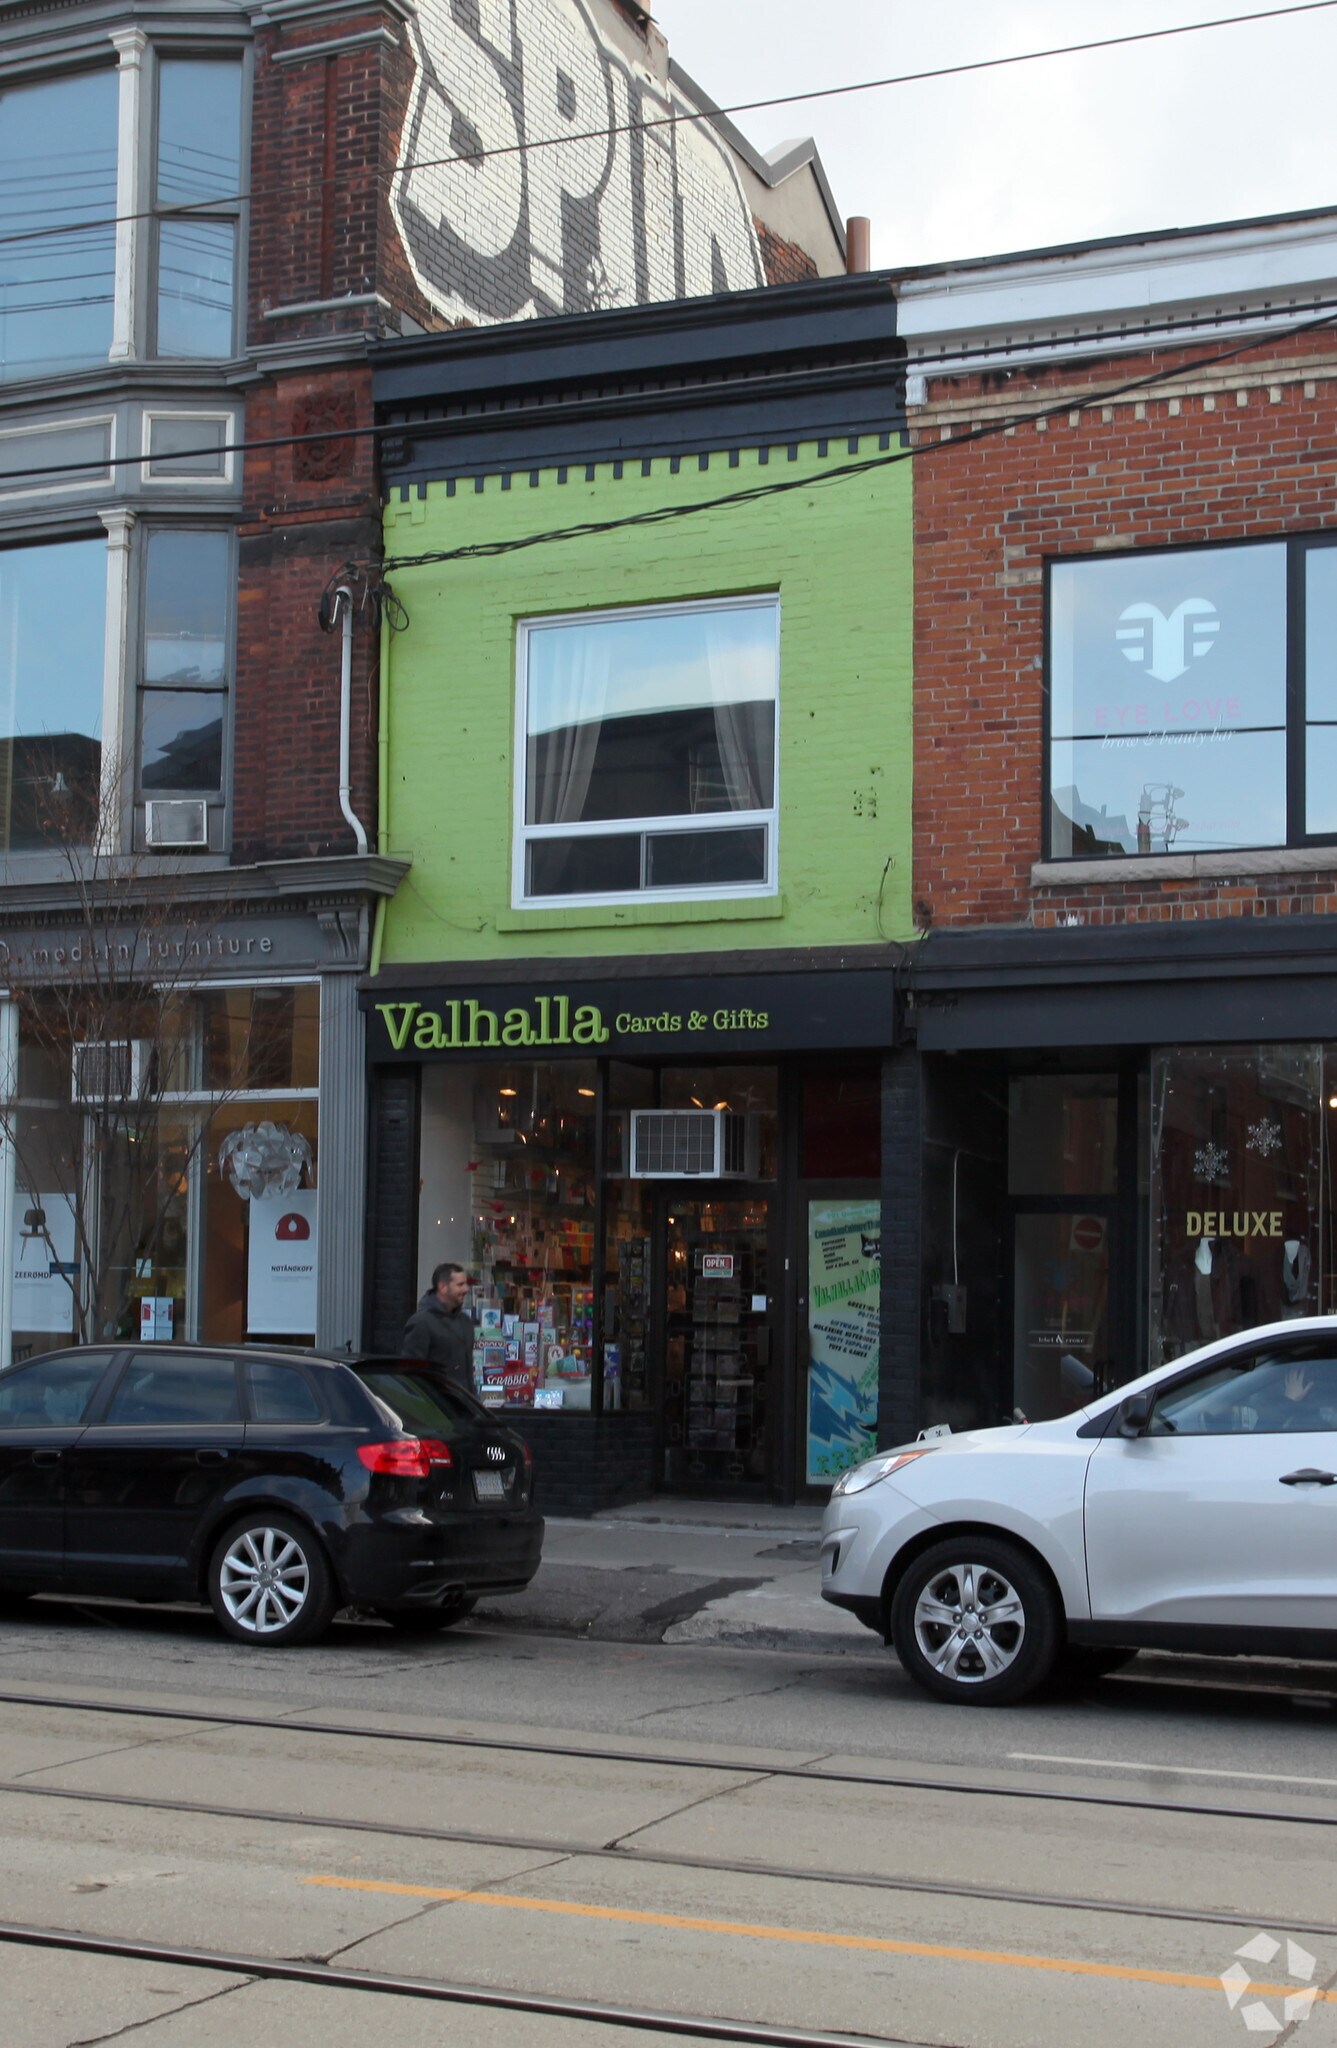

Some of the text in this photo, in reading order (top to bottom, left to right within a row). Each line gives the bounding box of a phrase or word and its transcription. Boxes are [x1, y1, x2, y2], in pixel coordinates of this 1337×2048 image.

[1094, 695, 1242, 729] EYE LOVE
[1101, 734, 1139, 750] brow
[1159, 729, 1207, 748] beauty
[33, 937, 129, 963] modern
[145, 930, 272, 957] furniture
[375, 995, 769, 1050] Valhalla Cards & Gifts
[1186, 1210, 1284, 1238] DELUXE
[706, 1258, 725, 1268] OPEN
